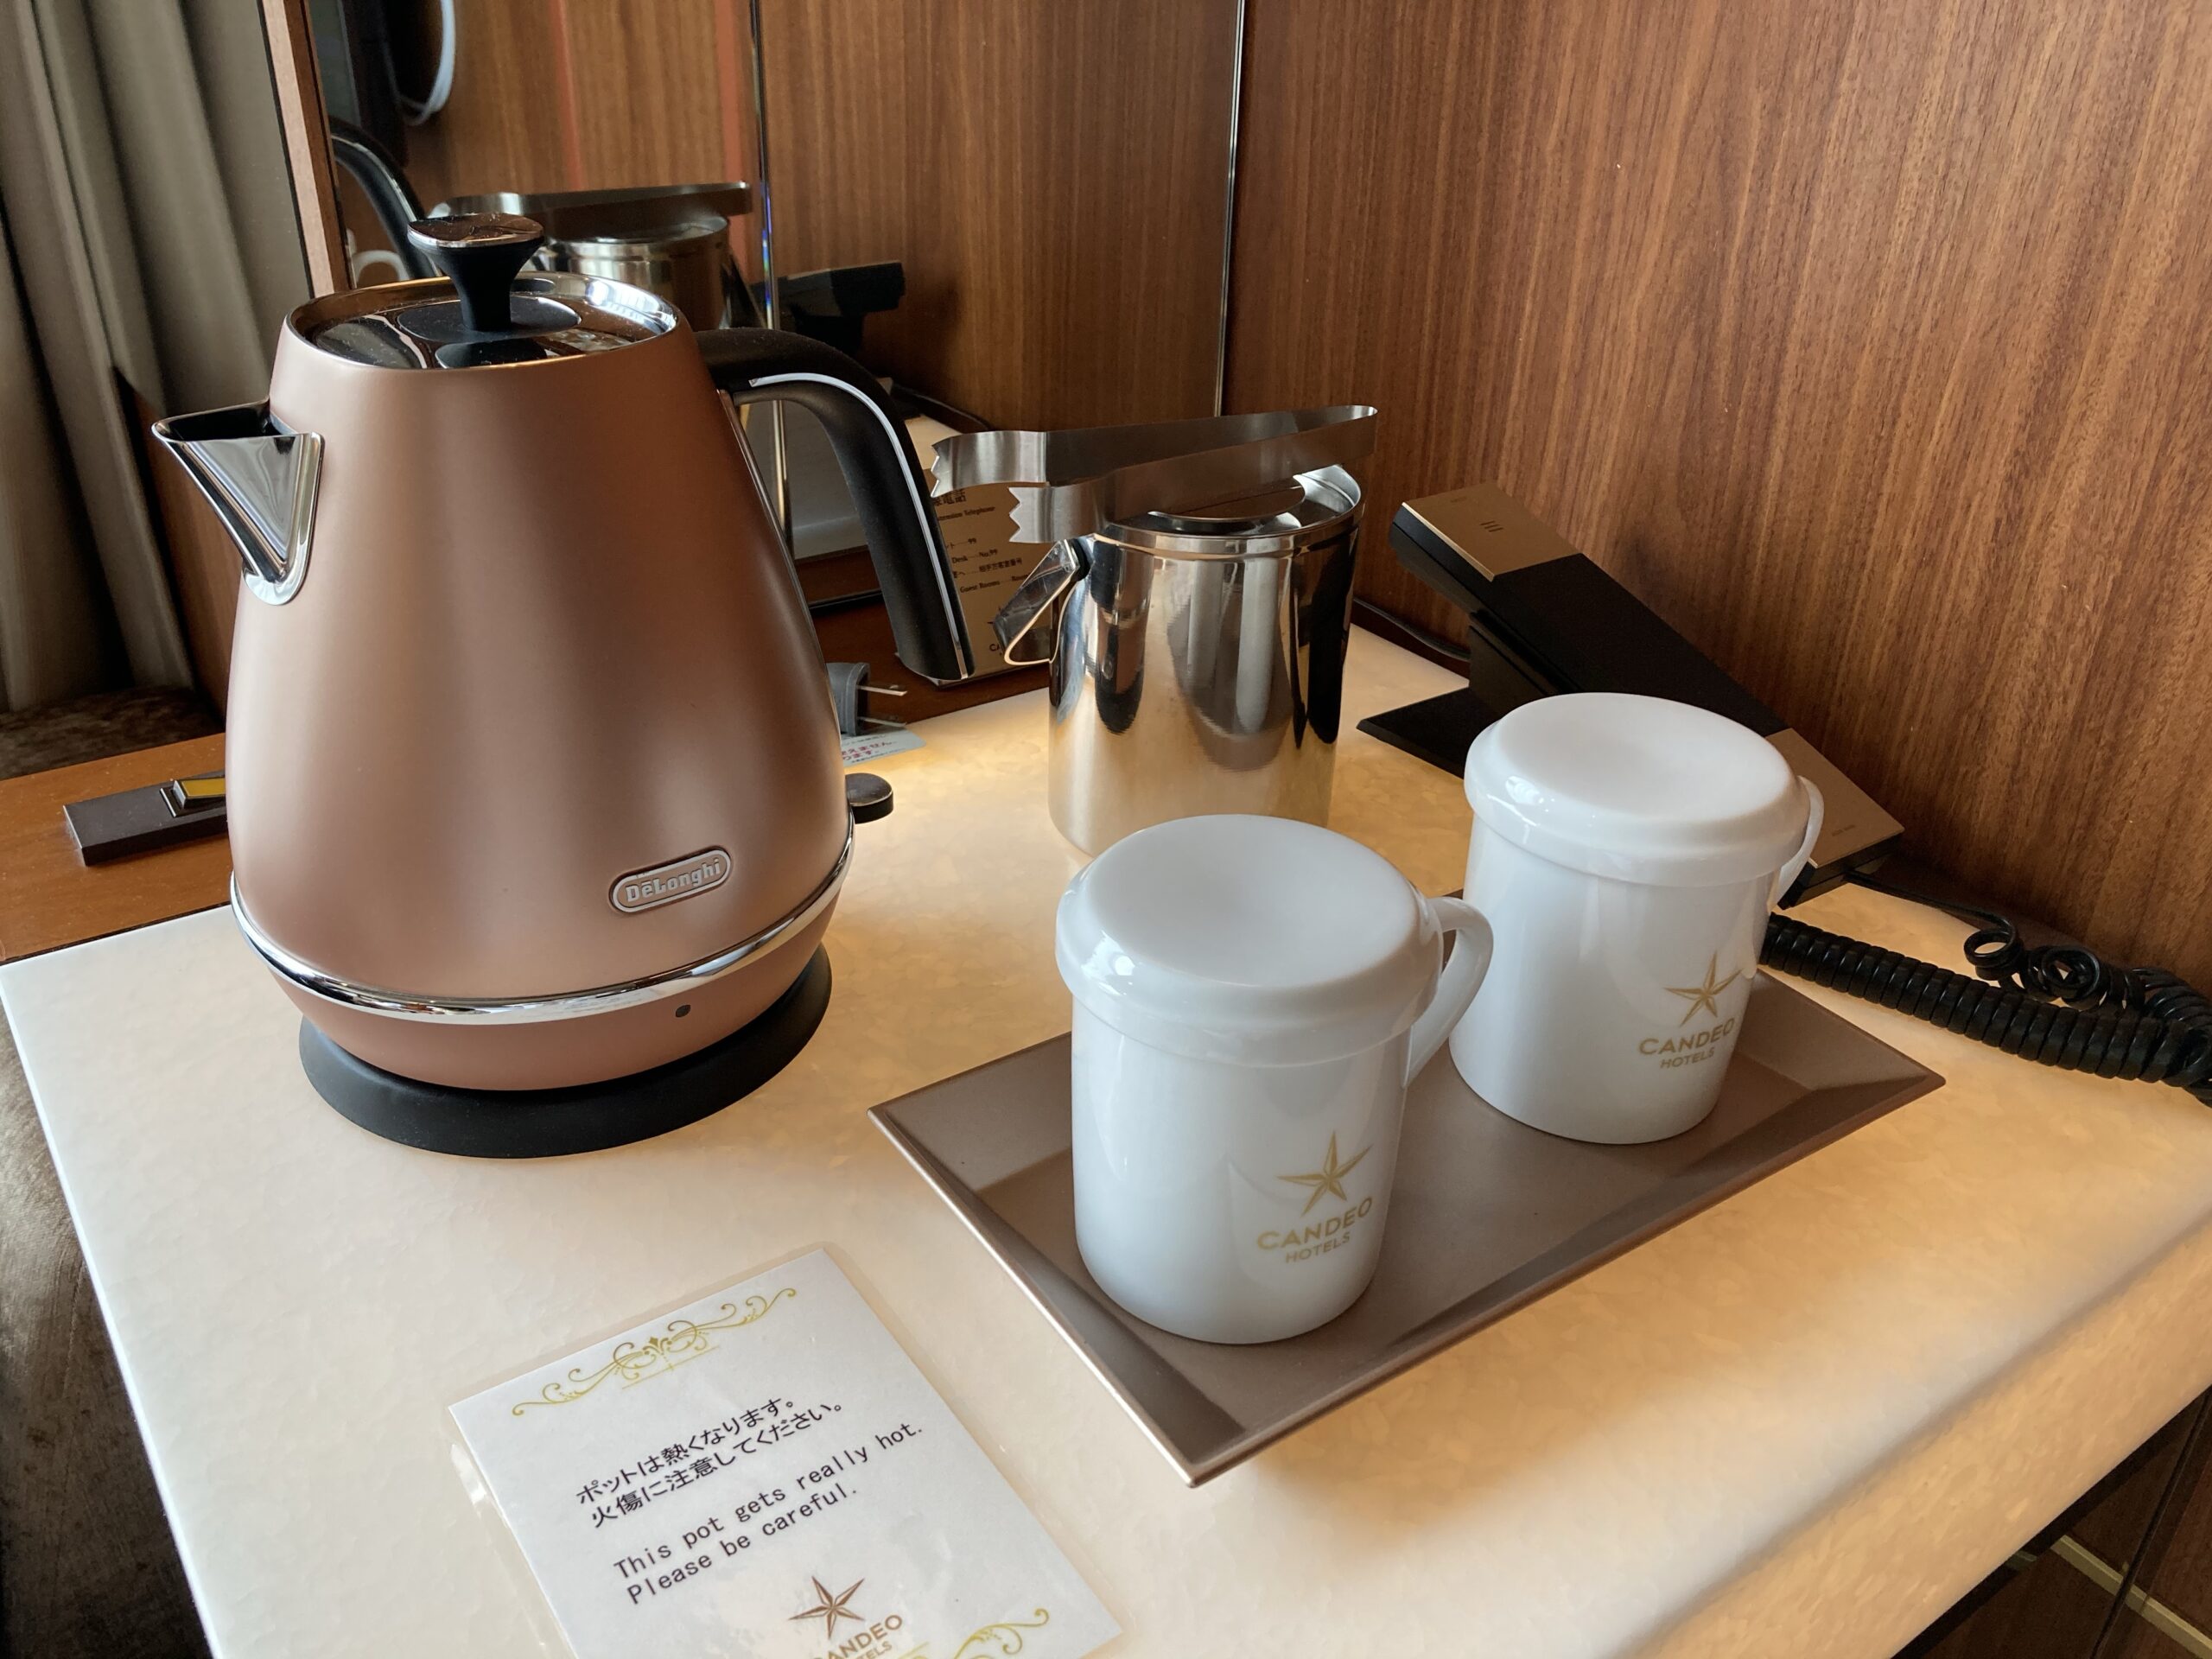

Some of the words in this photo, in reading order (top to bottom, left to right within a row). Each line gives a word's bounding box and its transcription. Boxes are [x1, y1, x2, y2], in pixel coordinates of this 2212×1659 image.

[1638, 1017, 1735, 1056] CANDEO
[1660, 1046, 1715, 1069] HOTELS
[1256, 1196, 1372, 1250] CANDEO
[1285, 1230, 1351, 1263] HOTELS
[576, 1397, 793, 1504] ポットは熱くなります。
[592, 1404, 842, 1528] 火傷に注意してください。
[613, 1544, 671, 1579] This
[682, 1516, 724, 1548] pot
[735, 1488, 785, 1522] gets
[796, 1446, 868, 1490] really
[874, 1423, 922, 1449] hot.
[626, 1554, 712, 1605] Please
[720, 1535, 751, 1556] be
[762, 1483, 856, 1536] careful.
